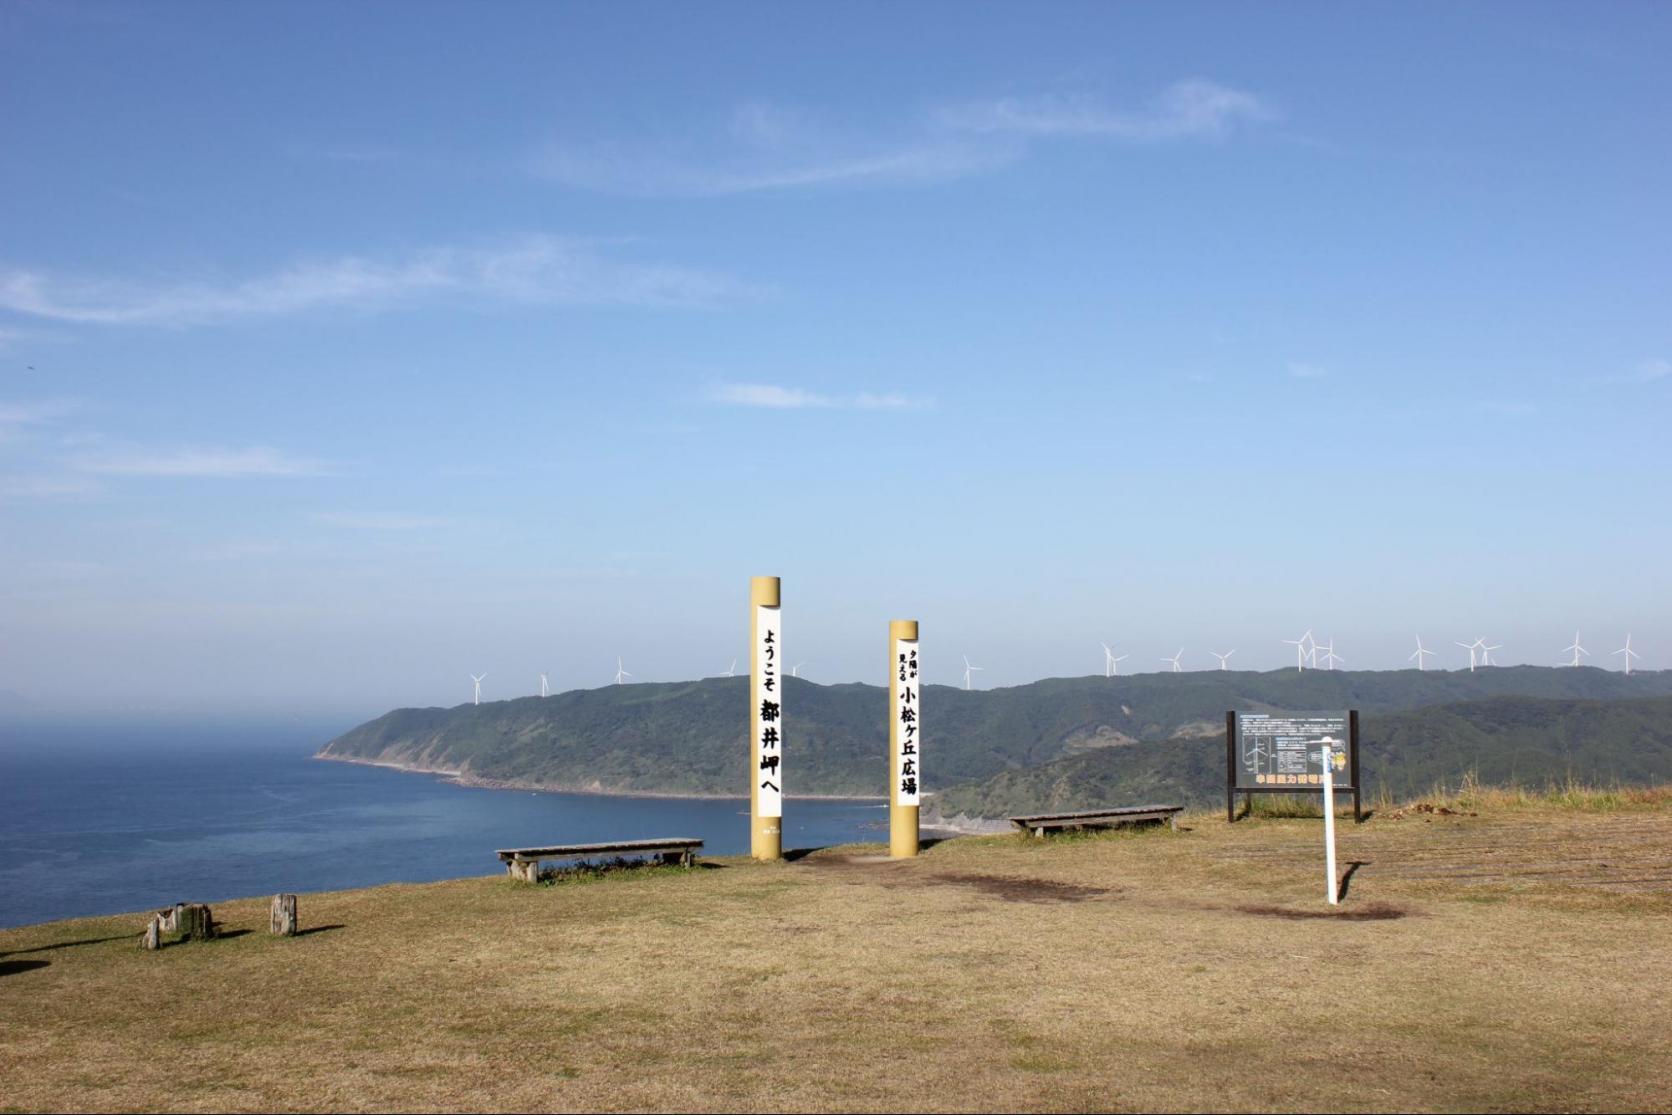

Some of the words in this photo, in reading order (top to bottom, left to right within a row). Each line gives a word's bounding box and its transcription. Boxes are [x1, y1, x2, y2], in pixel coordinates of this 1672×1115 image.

[764, 629, 776, 692] ようこそ
[760, 698, 780, 793] 都井岬へ
